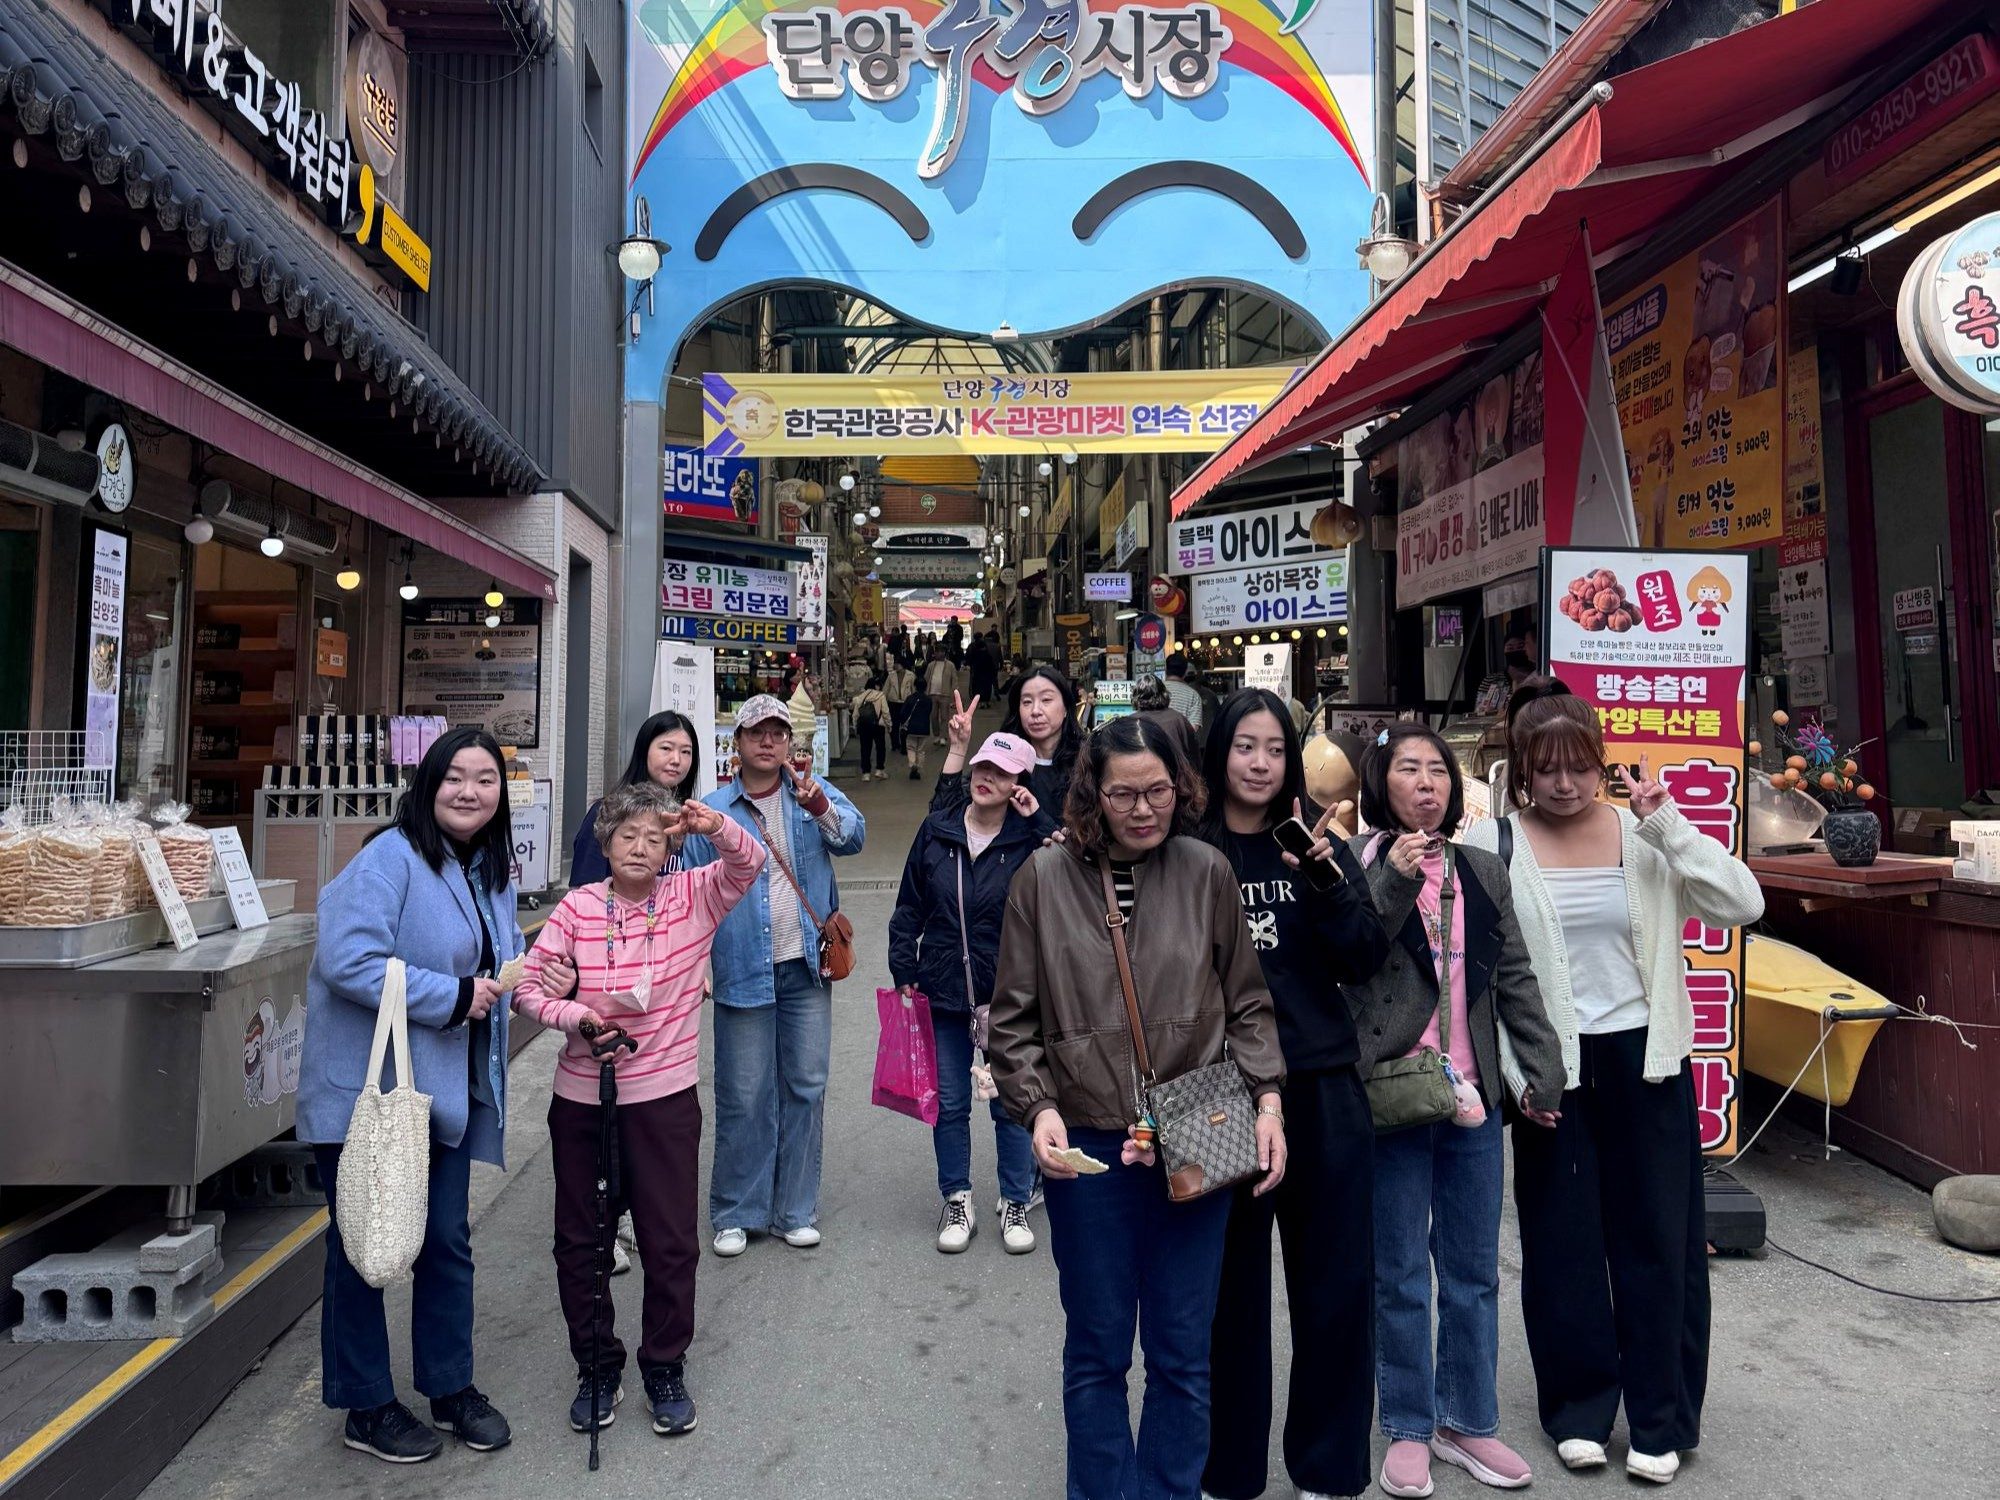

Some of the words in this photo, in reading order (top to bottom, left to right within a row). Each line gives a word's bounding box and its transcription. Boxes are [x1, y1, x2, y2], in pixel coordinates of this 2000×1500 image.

[1831, 45, 1977, 169] 010-3450-9921
[383, 221, 408, 257] CUSTOMER
[409, 243, 429, 276] SHELTER
[784, 407, 964, 438] 한국관광공사
[971, 405, 1126, 436] K-관광마켓
[1132, 404, 1190, 434] 연속
[1706, 406, 1733, 442] 먹는
[1706, 477, 1736, 514] 먹는
[1178, 524, 1214, 547] 블랙
[1220, 508, 1334, 562] 아이스
[1178, 546, 1215, 569] 핑크
[94, 575, 120, 599] 흑마늘
[663, 562, 688, 581] 장
[696, 565, 749, 587] 유기농
[1090, 578, 1126, 587] COFFEE
[1243, 566, 1322, 597] 상하목장
[93, 600, 119, 624] 단양갱
[723, 590, 789, 616] 전문점
[1641, 575, 1677, 628] 원조
[713, 619, 788, 642] COFFEE
[1569, 652, 1585, 661] 특허
[1585, 652, 1600, 661] 받은
[1601, 652, 1636, 661] 기술력으로
[1637, 653, 1672, 663] 이곳에서만
[1673, 652, 1691, 663] 제조
[1693, 653, 1711, 664] 판매
[1712, 655, 1733, 664] 합니다
[1580, 640, 1595, 649] 단양
[1596, 640, 1632, 650] 흑마늘빵은
[1634, 641, 1656, 651] 국내산
[1688, 642, 1724, 652] 만들었으며
[1096, 693, 1134, 703] 아이스크
[1595, 673, 1708, 705] 방송출연
